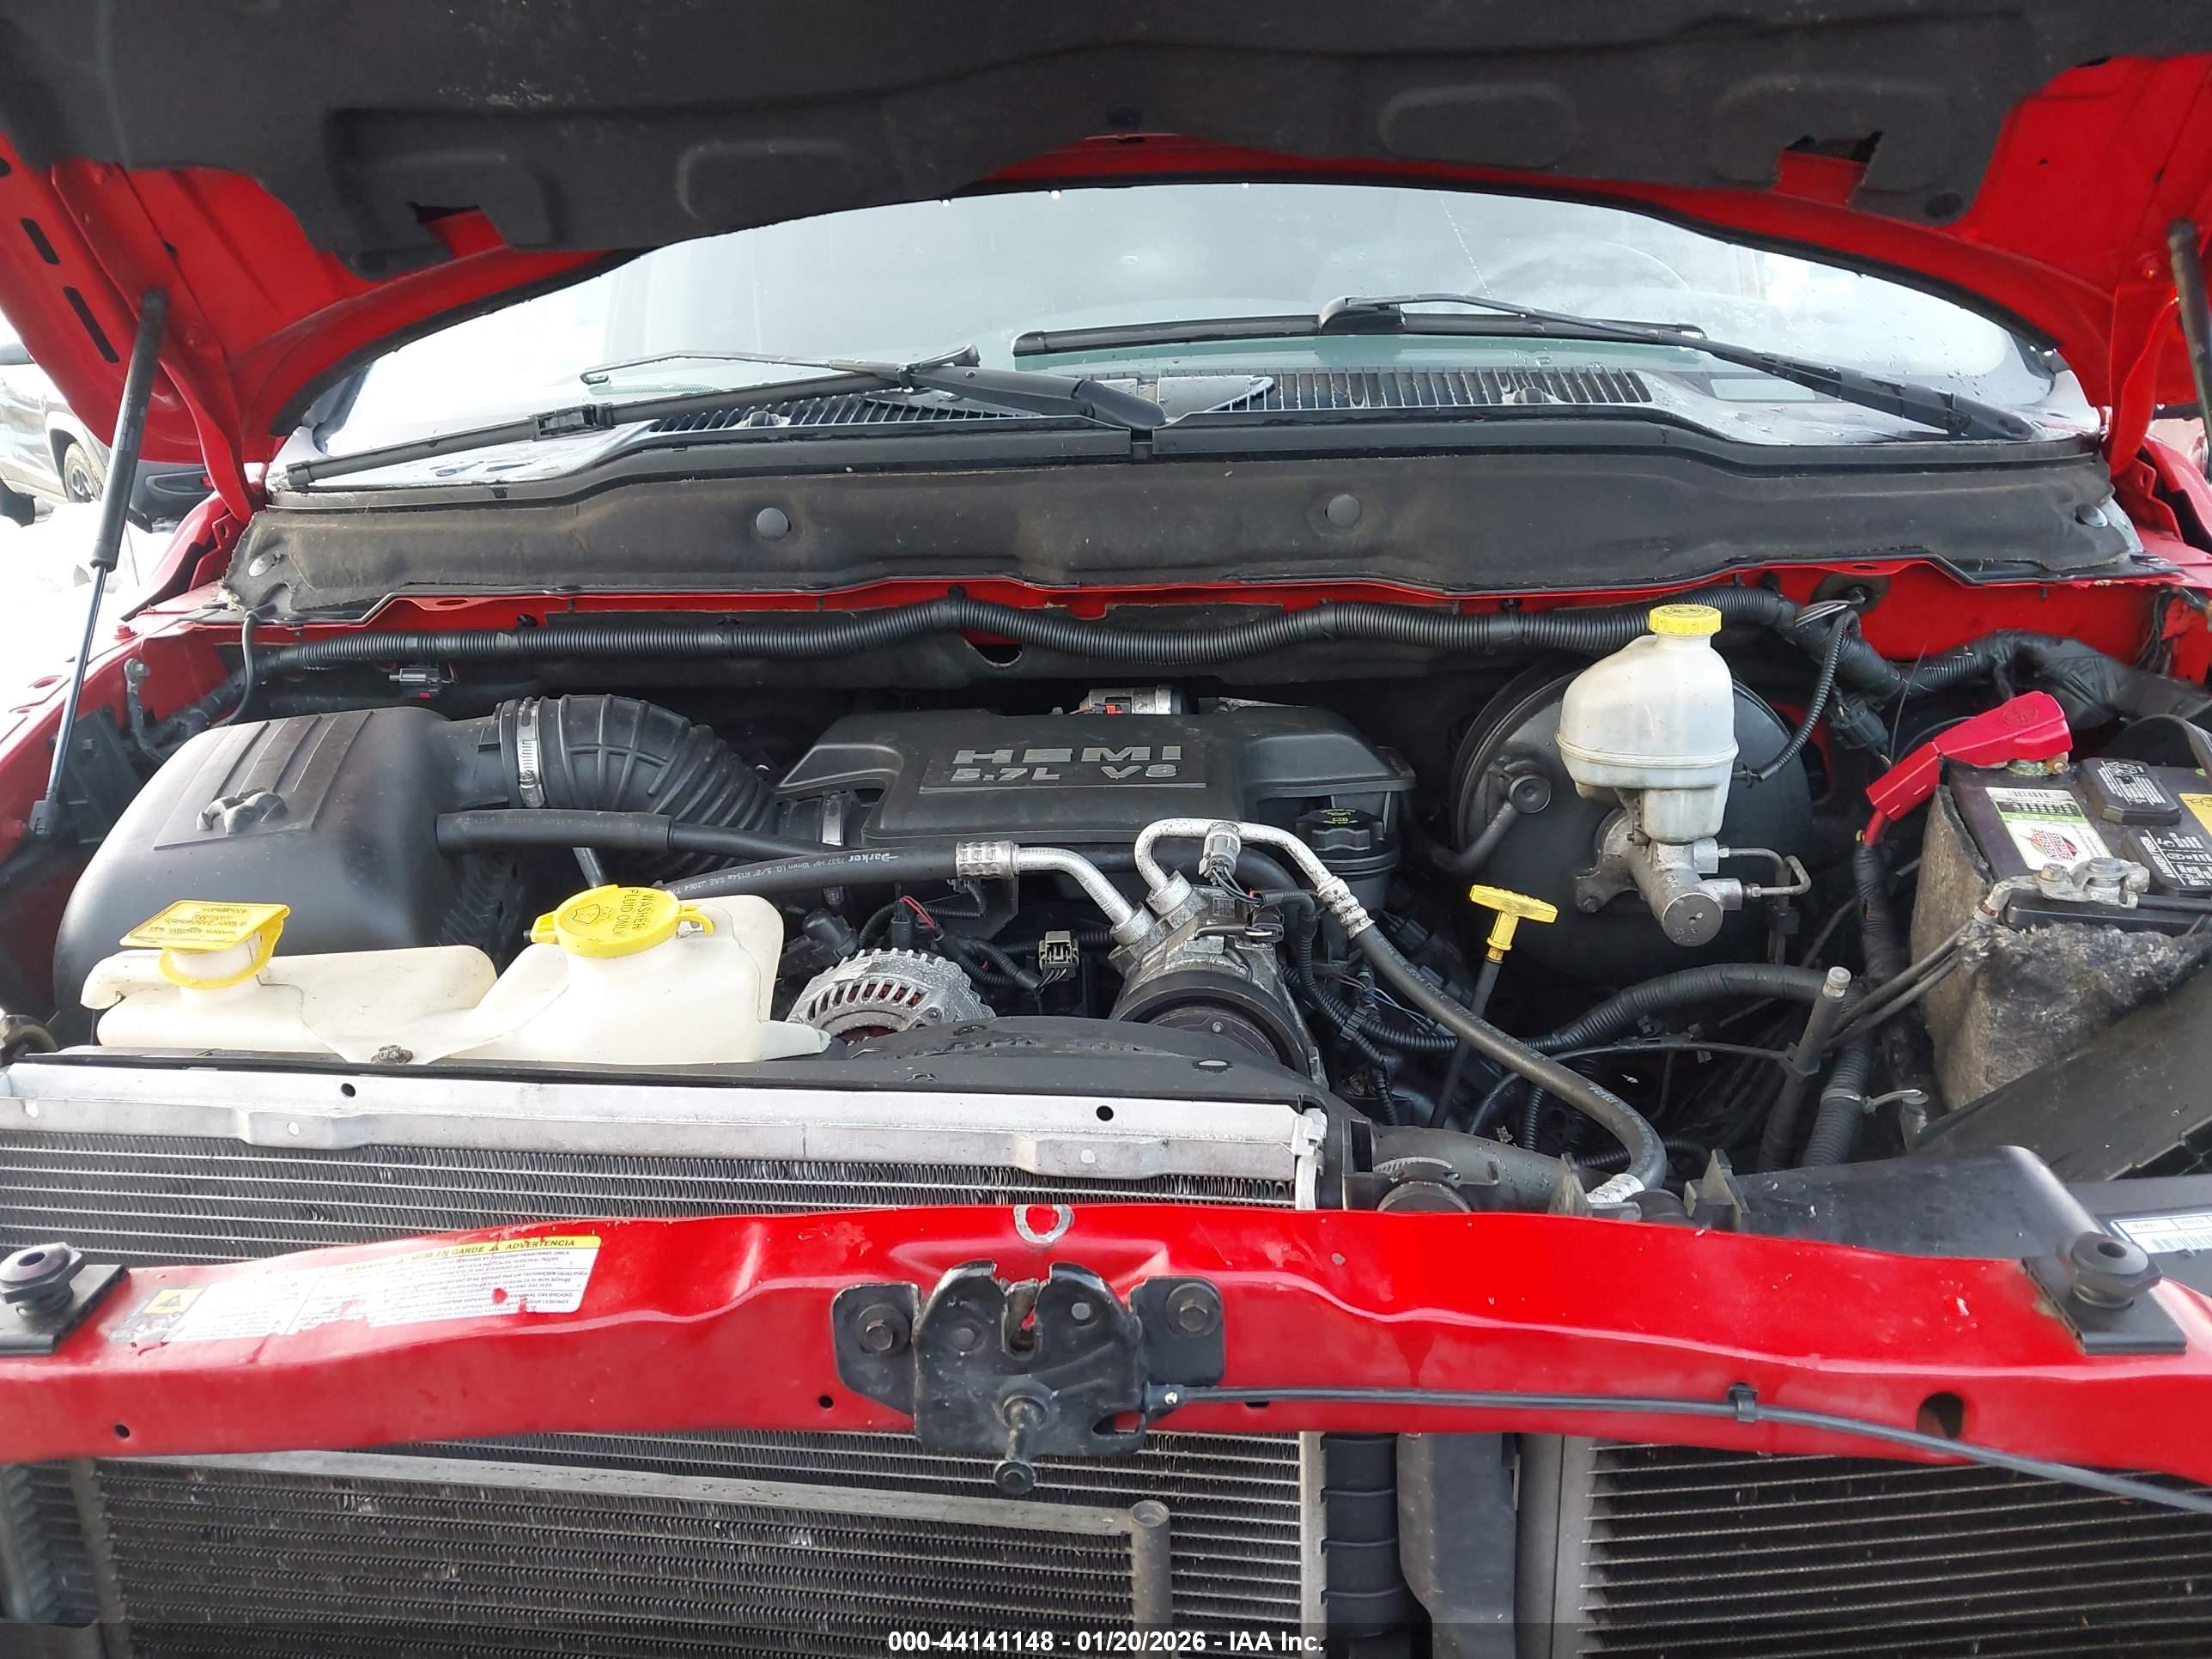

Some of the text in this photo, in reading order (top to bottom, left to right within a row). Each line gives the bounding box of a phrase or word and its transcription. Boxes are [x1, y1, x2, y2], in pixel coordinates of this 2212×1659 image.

[953, 745, 1182, 764] HEMI
[951, 763, 1178, 781] 5.7L V8
[848, 853, 891, 864] Parker
[612, 889, 640, 935] FLUID ONLY
[632, 893, 654, 929] WASHER
[452, 1246, 485, 1256] GARDE
[506, 1239, 574, 1250] ADVERTENCIA
